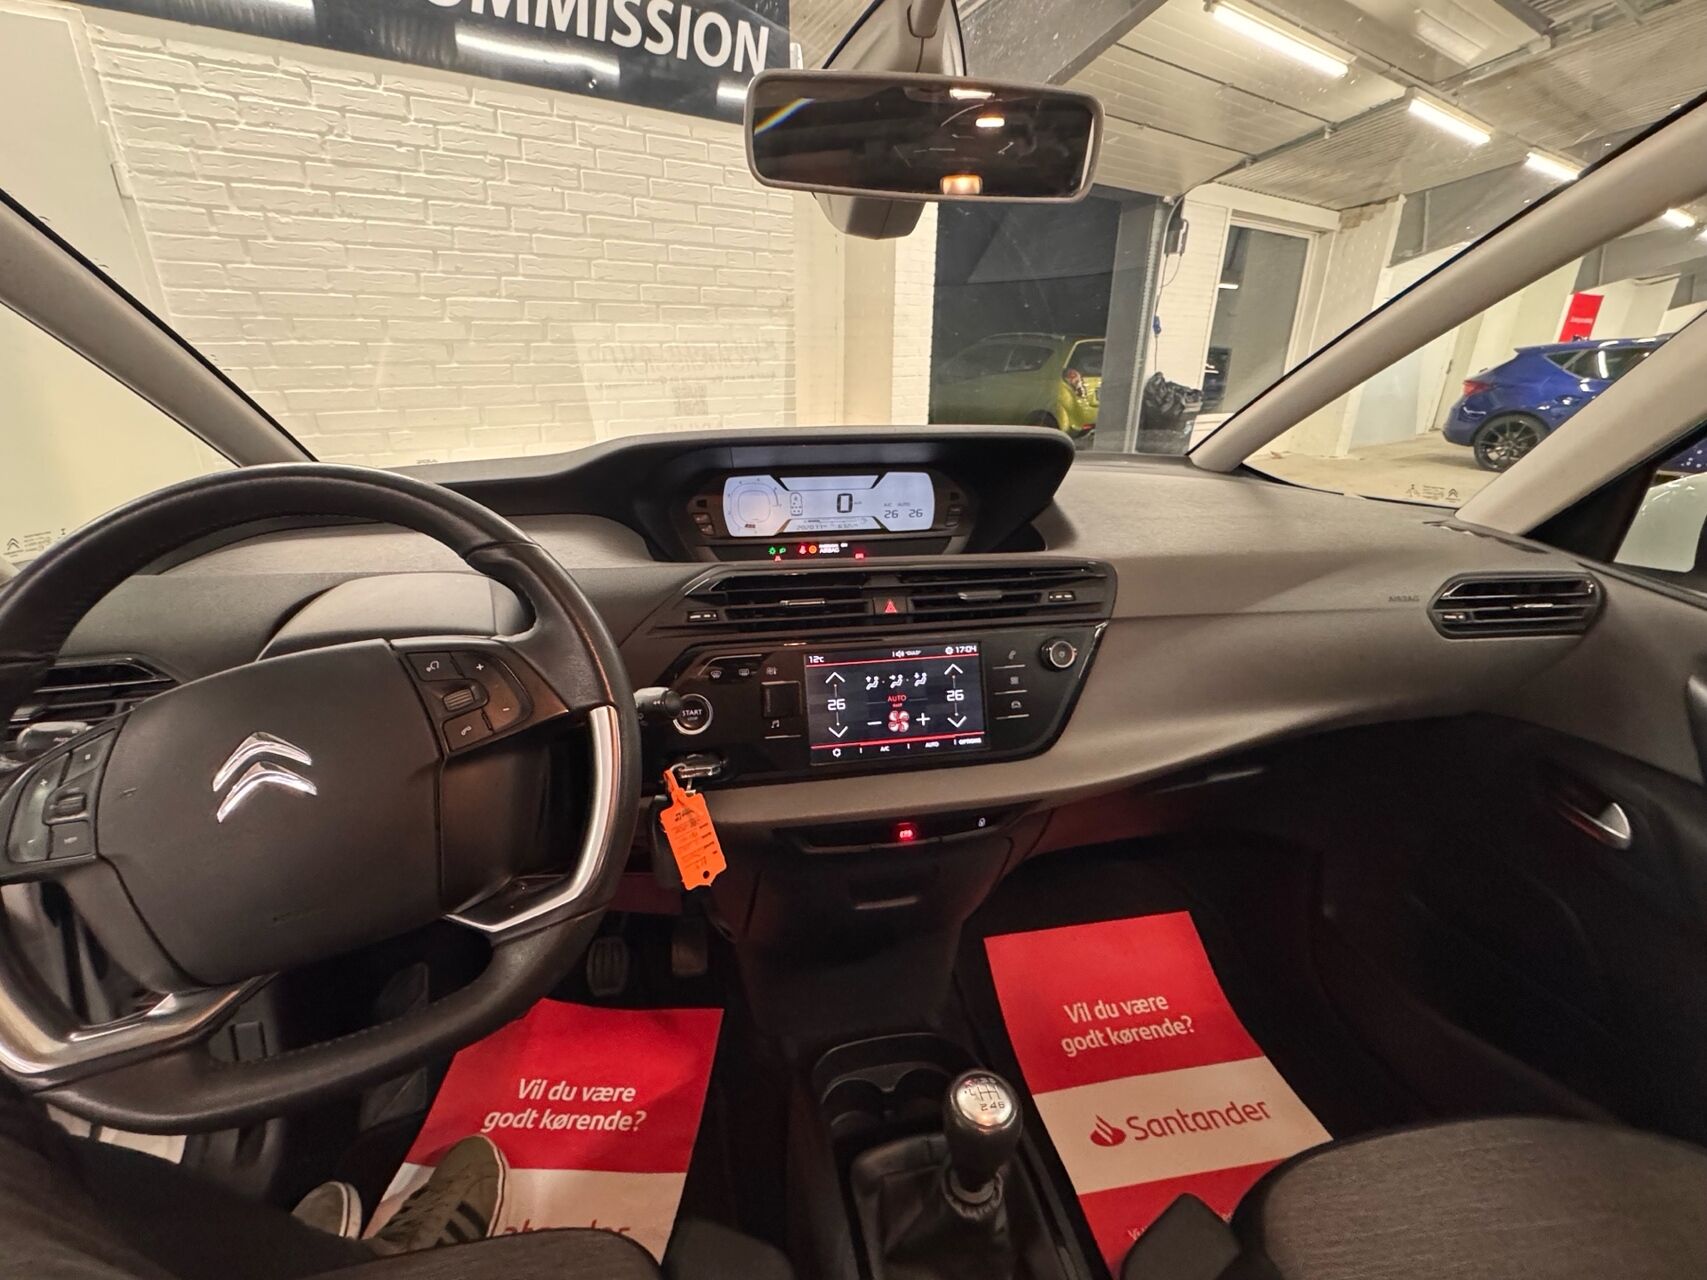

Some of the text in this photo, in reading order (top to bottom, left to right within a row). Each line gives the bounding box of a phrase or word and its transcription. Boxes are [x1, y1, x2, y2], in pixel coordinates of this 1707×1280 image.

[428, 0, 769, 76] MISSION
[837, 493, 853, 513] 0
[884, 508, 923, 518] 26 26
[955, 645, 977, 654] 17:04
[827, 699, 846, 711] 26
[887, 694, 907, 702] AUTO
[946, 689, 964, 701] 26
[682, 708, 702, 717] START
[1063, 995, 1169, 1024] Vil du være
[1060, 1016, 1195, 1057] godt kørende?
[518, 1078, 637, 1102] Vil du være
[480, 1108, 647, 1133] godt kørende?
[1126, 1099, 1272, 1142] Santander
